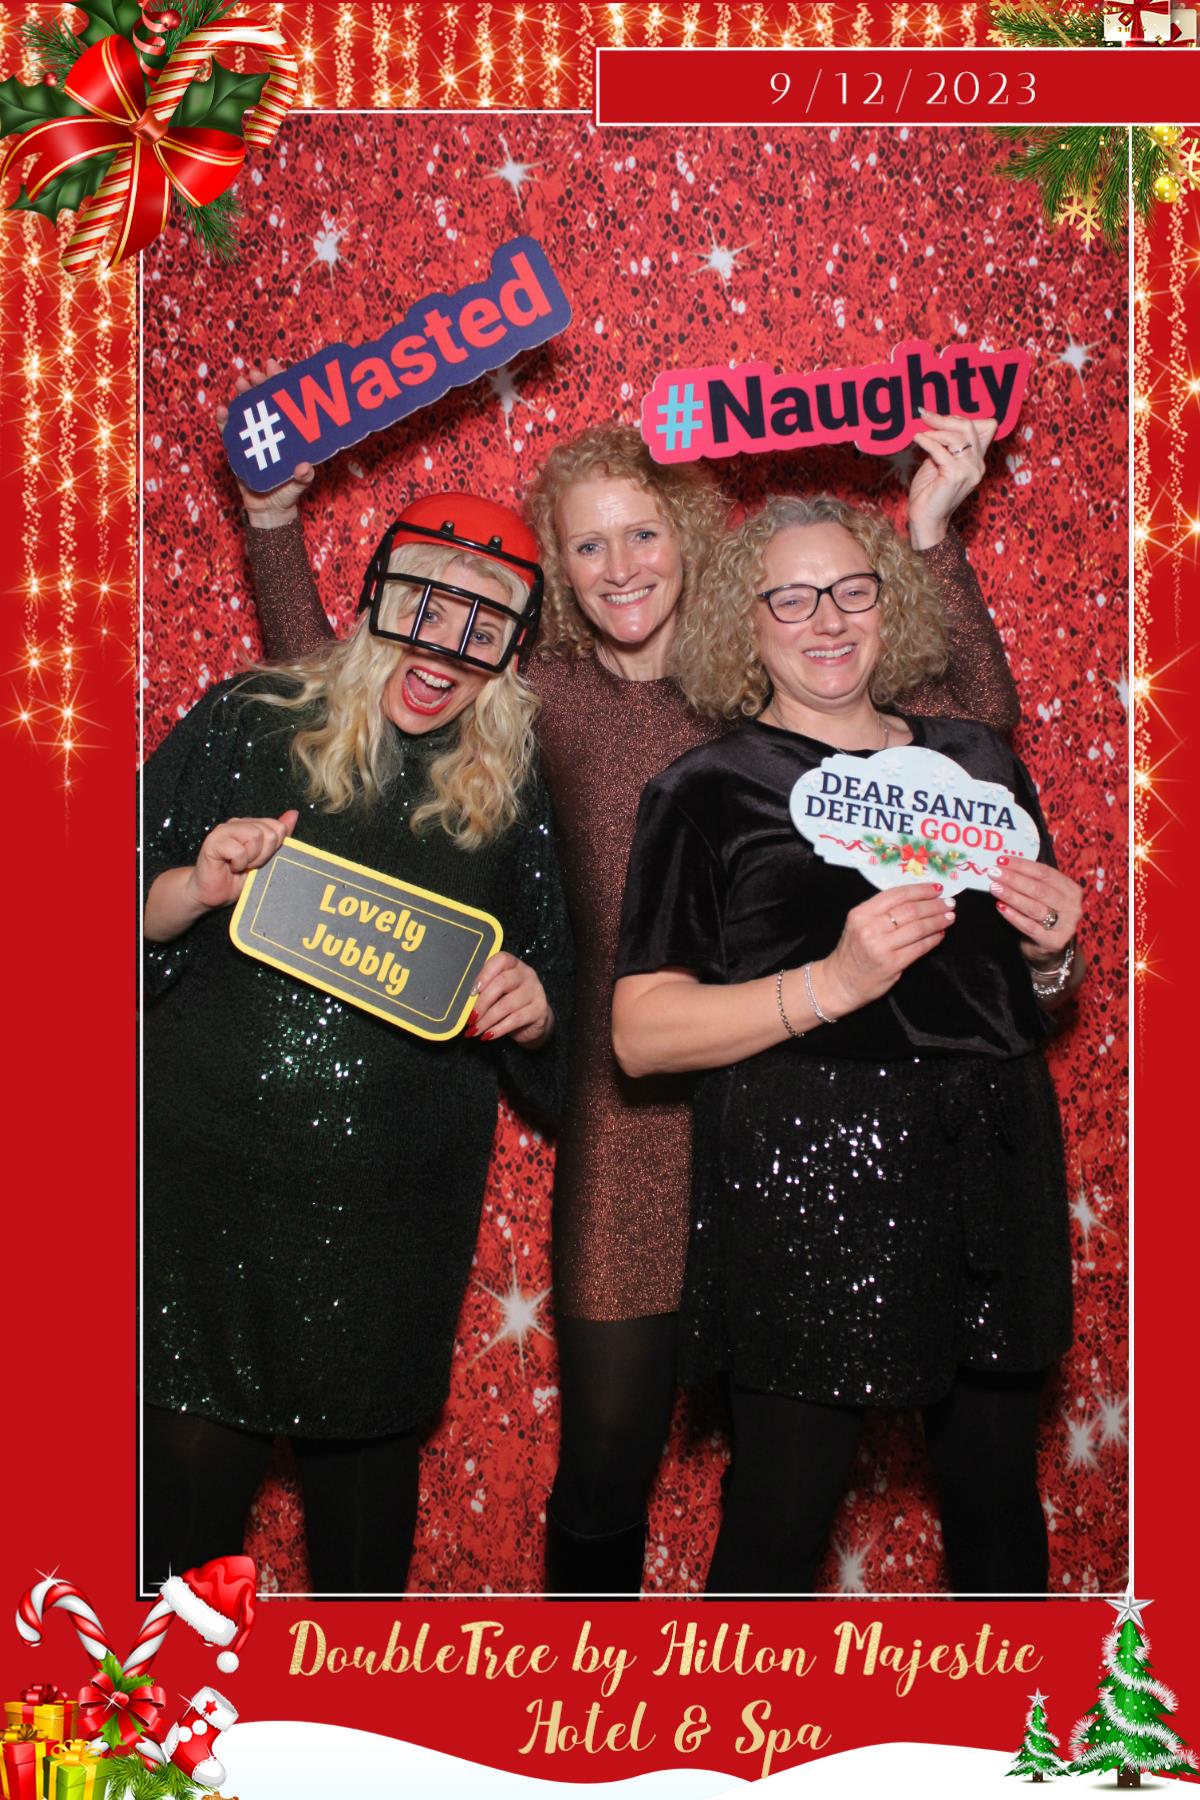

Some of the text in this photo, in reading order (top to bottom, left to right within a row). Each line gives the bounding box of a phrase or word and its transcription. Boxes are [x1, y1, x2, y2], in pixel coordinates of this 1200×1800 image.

[238, 253, 553, 471] #Wasted
[656, 353, 1020, 450] #Naughty
[804, 795, 1024, 857] DEFINE GOOD...
[820, 771, 1017, 831] DEAR SANTA
[319, 884, 427, 953] Lovely
[302, 923, 410, 996] Jubbly
